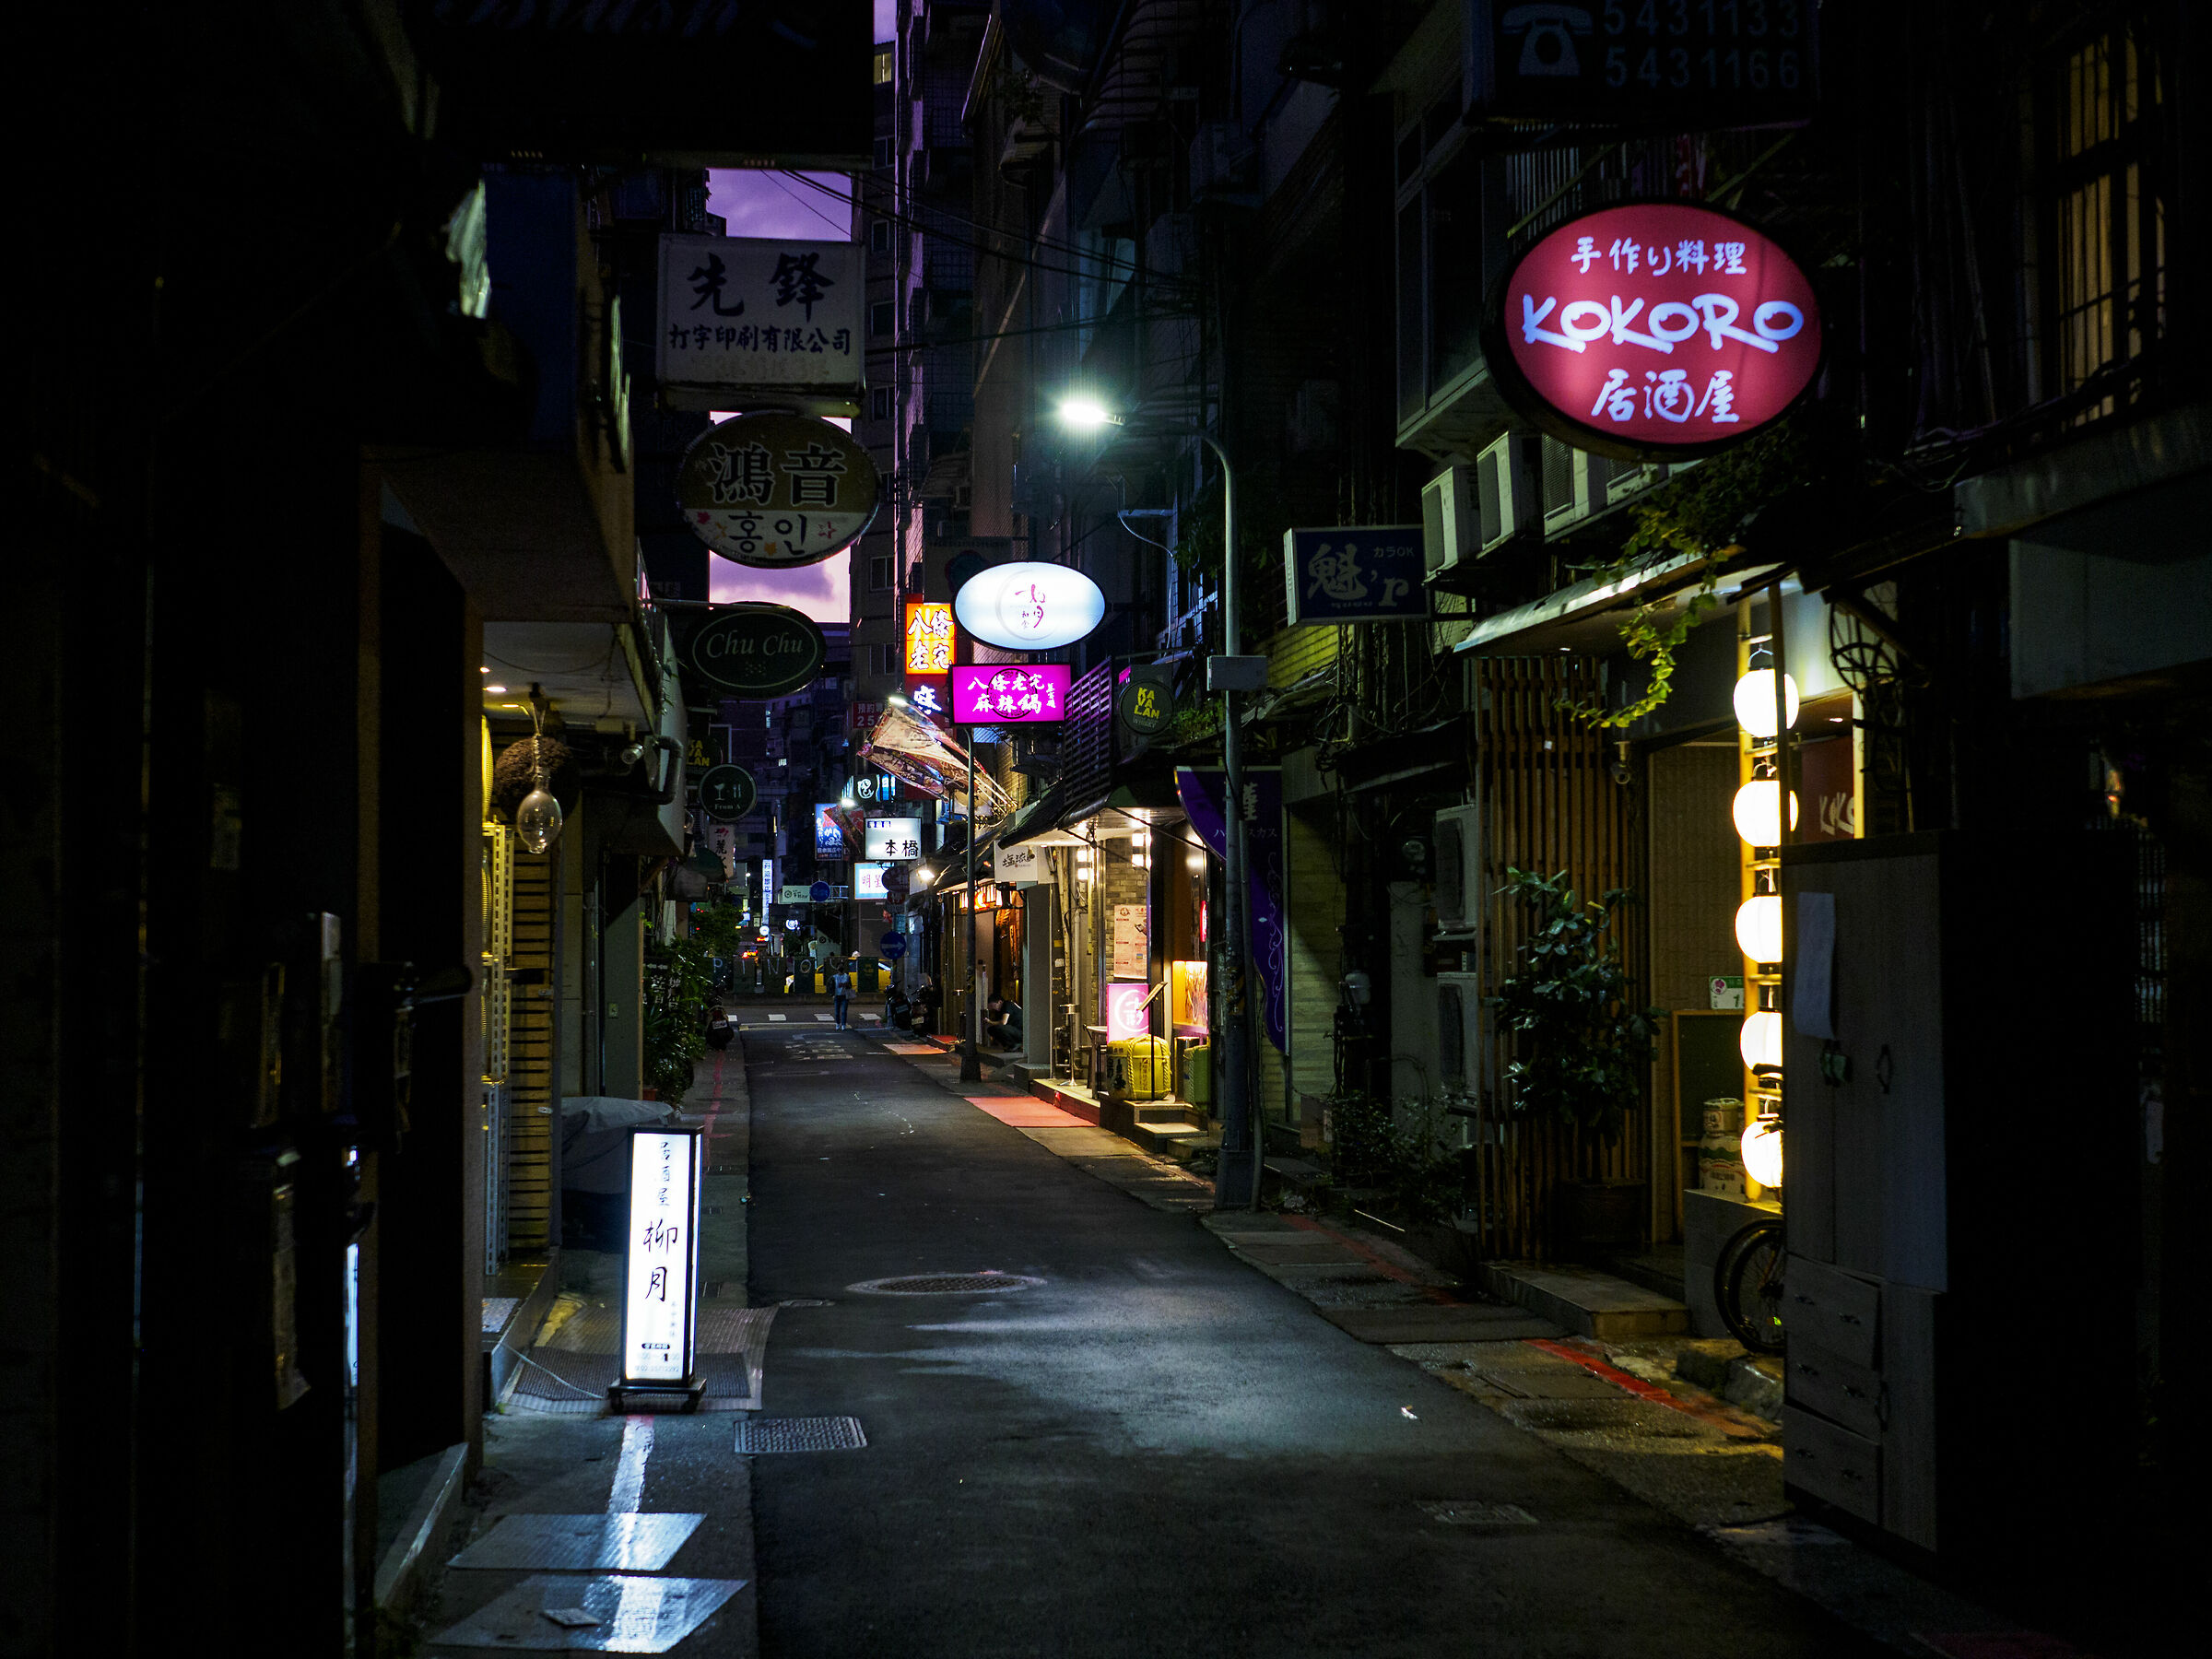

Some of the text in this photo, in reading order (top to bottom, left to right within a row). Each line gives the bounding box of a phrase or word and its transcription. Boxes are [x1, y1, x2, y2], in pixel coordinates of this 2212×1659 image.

[1604, 45, 1800, 89] 5431166
[1571, 236, 1747, 276] 手作り料理
[688, 252, 834, 323] 先鋒
[669, 324, 851, 355] 打字印刷有限公司
[1522, 292, 1805, 355] KOKORO
[1591, 369, 1740, 424] 居酒屋
[707, 441, 848, 507] 鴻音
[728, 511, 808, 556] 홍인
[706, 629, 804, 658] Chu Chu
[972, 693, 1042, 714] 麻辣鍋
[643, 1217, 678, 1303] 柳月
